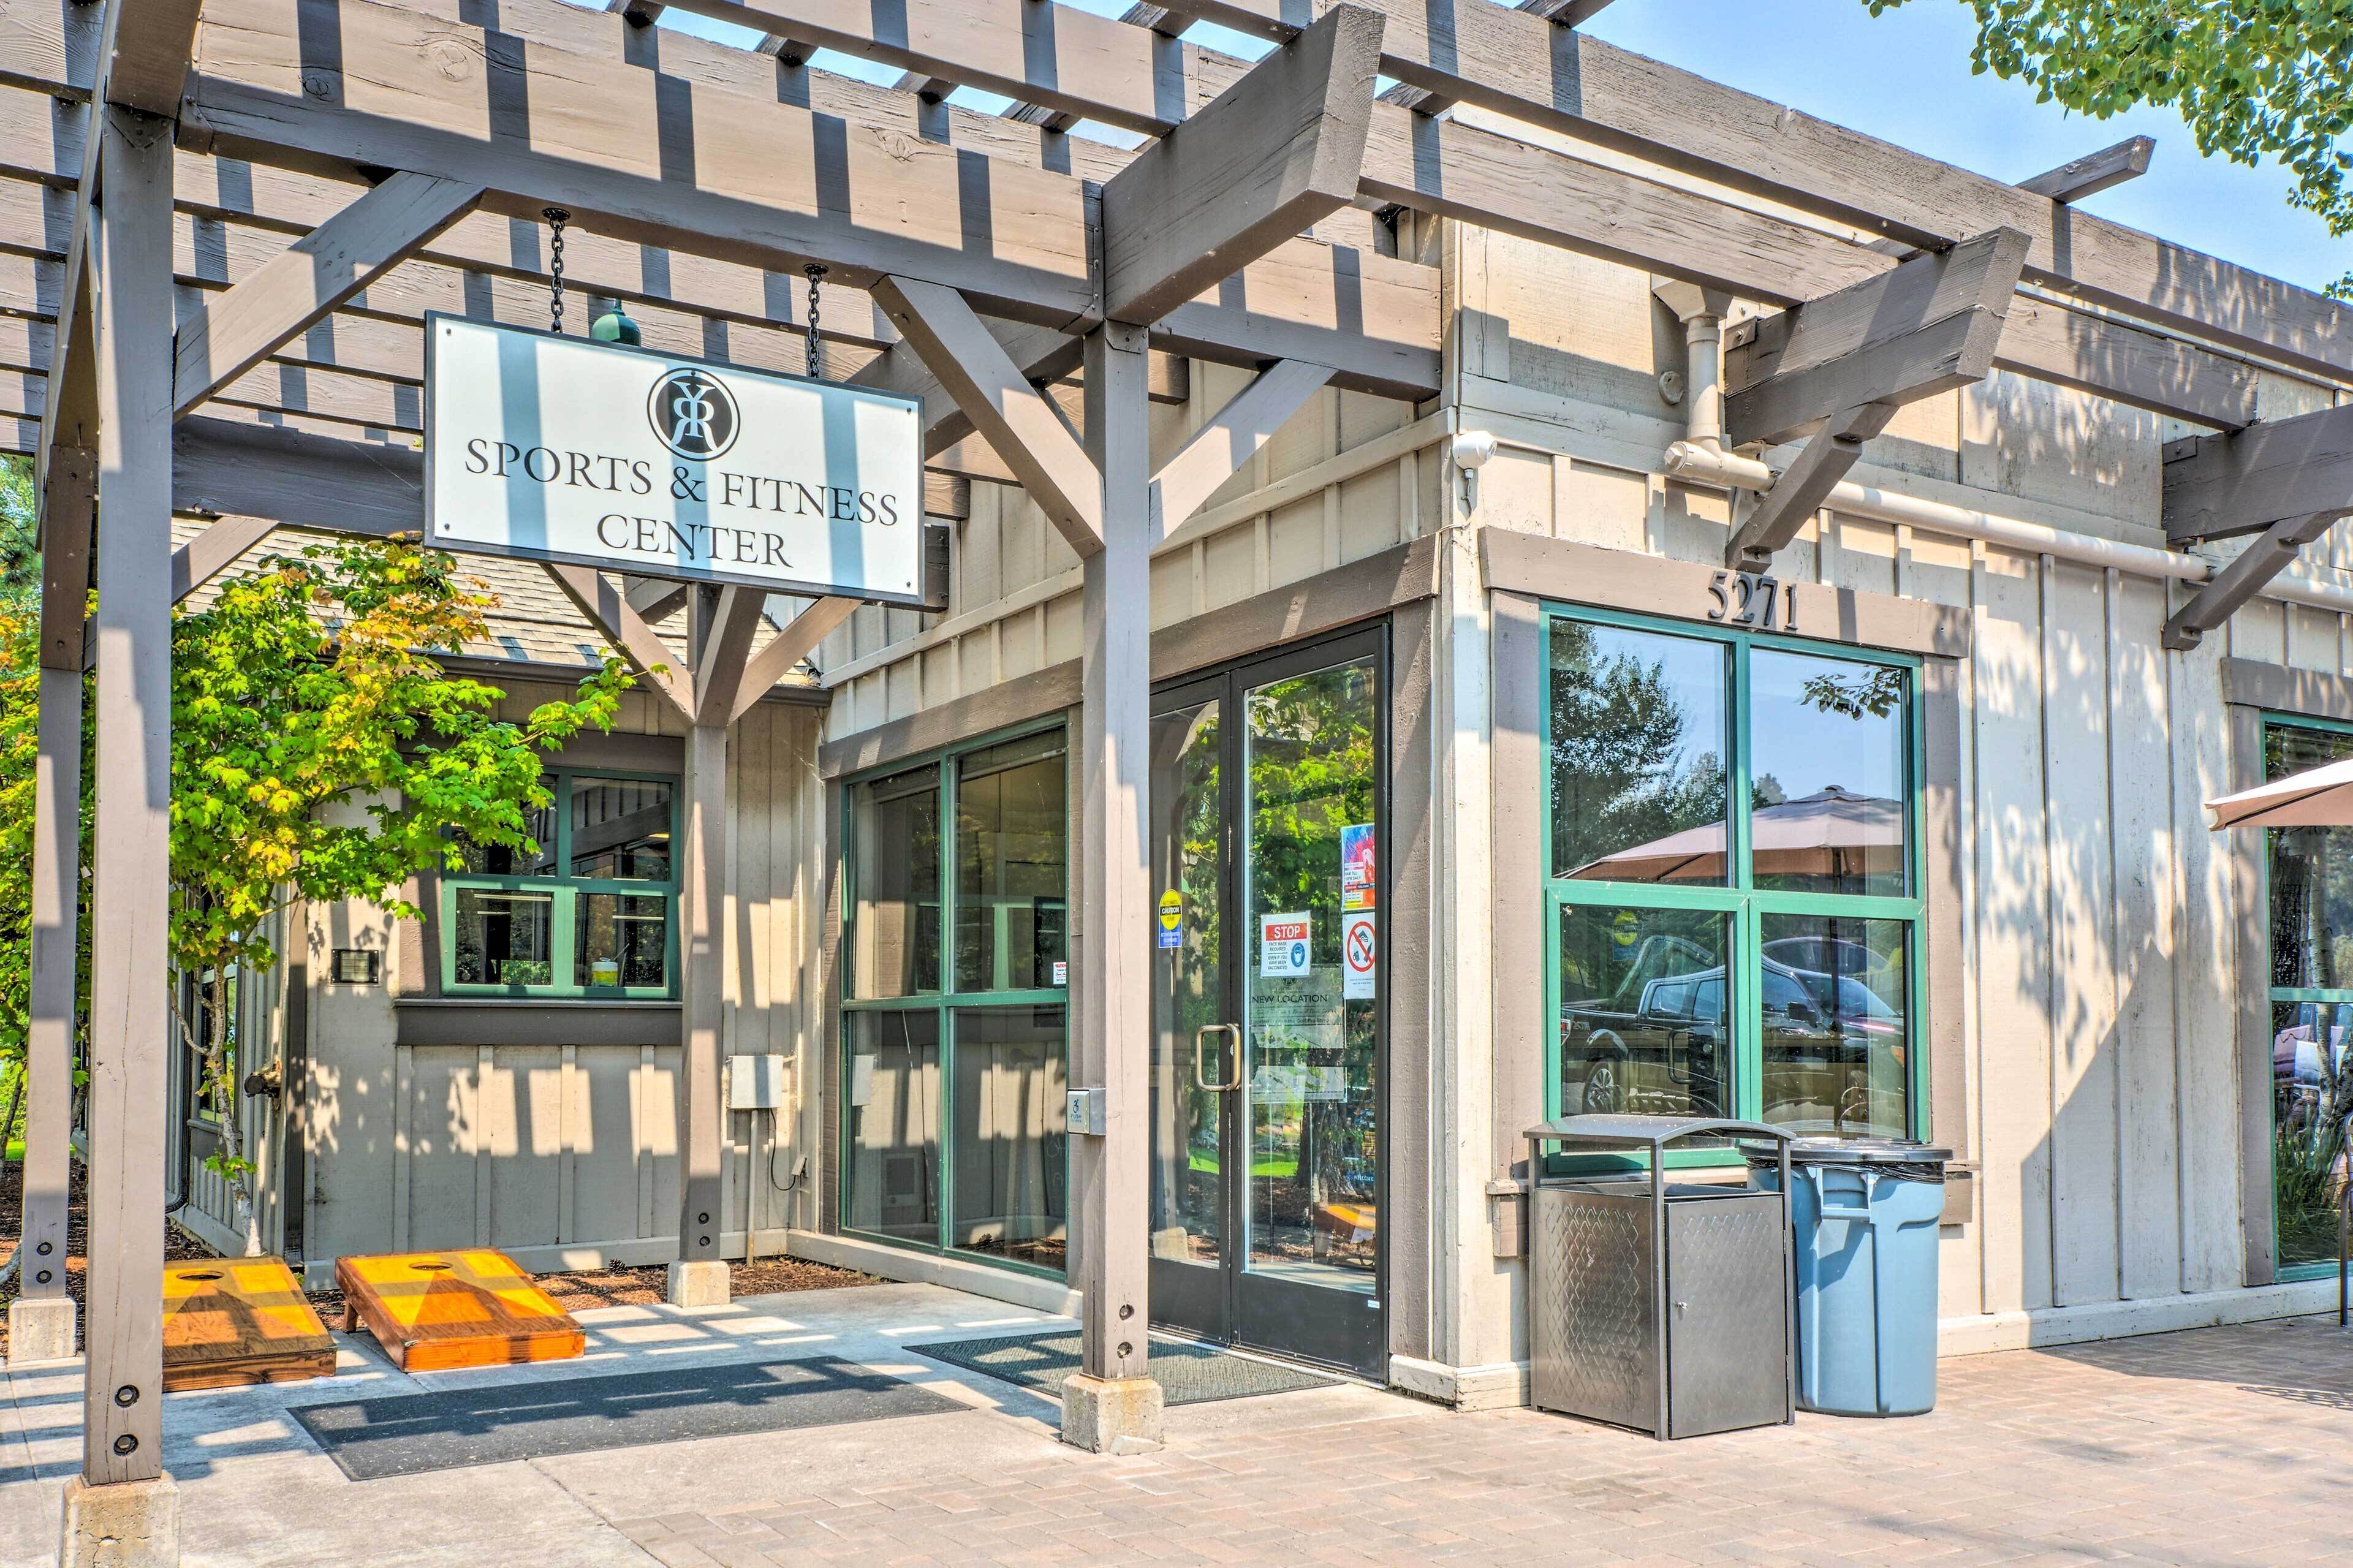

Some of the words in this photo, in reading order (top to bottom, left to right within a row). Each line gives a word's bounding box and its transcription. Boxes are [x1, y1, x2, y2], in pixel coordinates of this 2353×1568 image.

[465, 438, 652, 494] SPORTS
[670, 466, 707, 502] &
[720, 472, 898, 526] FITNESS
[597, 514, 794, 568] CENTER
[1708, 570, 1798, 630] 5271
[1275, 926, 1300, 939] STOP
[1278, 994, 1328, 1002] LOCATION
